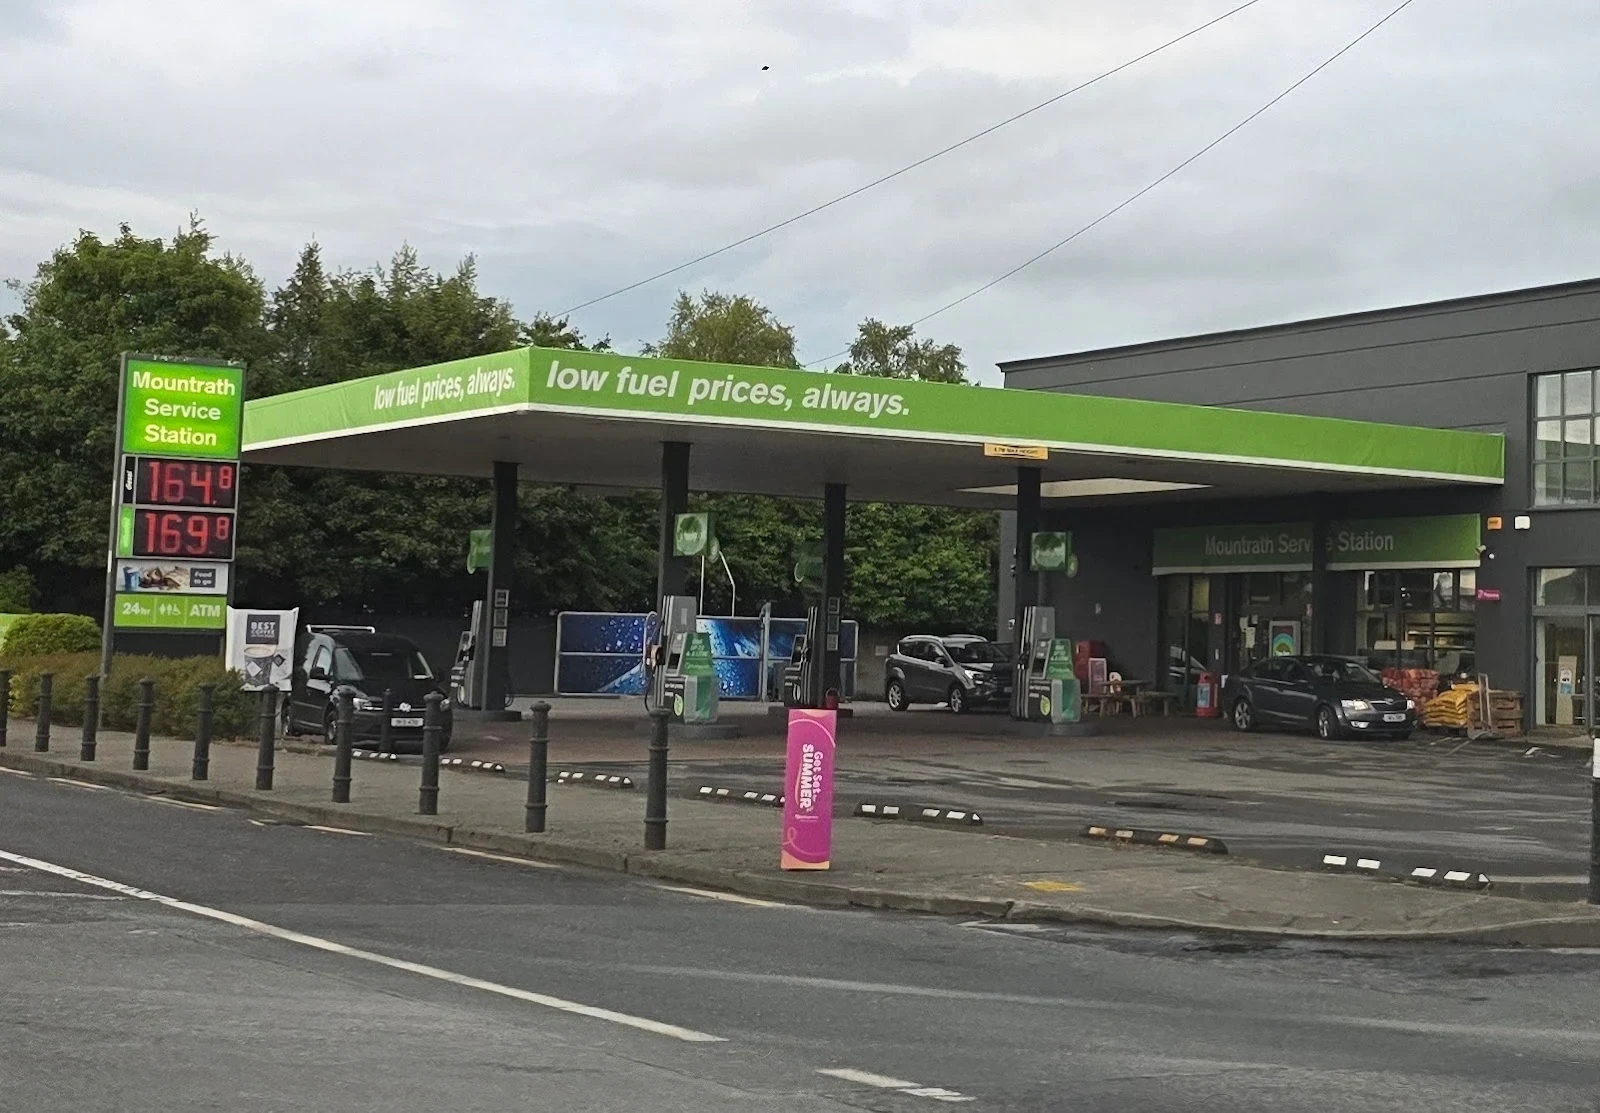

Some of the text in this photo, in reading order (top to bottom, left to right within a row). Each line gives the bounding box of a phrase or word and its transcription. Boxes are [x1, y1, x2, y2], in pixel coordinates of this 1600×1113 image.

[132, 371, 236, 396] Mountrath
[373, 366, 515, 410] low fuel prices, always.
[546, 360, 910, 419] low fuel prices, always.
[144, 398, 221, 420] Service
[144, 424, 217, 446] Station
[1205, 535, 1274, 556] Mountrath
[1338, 530, 1394, 552] Station
[190, 604, 221, 618] ATM
[251, 621, 276, 630] BEST
[799, 743, 814, 809] SUMMER
